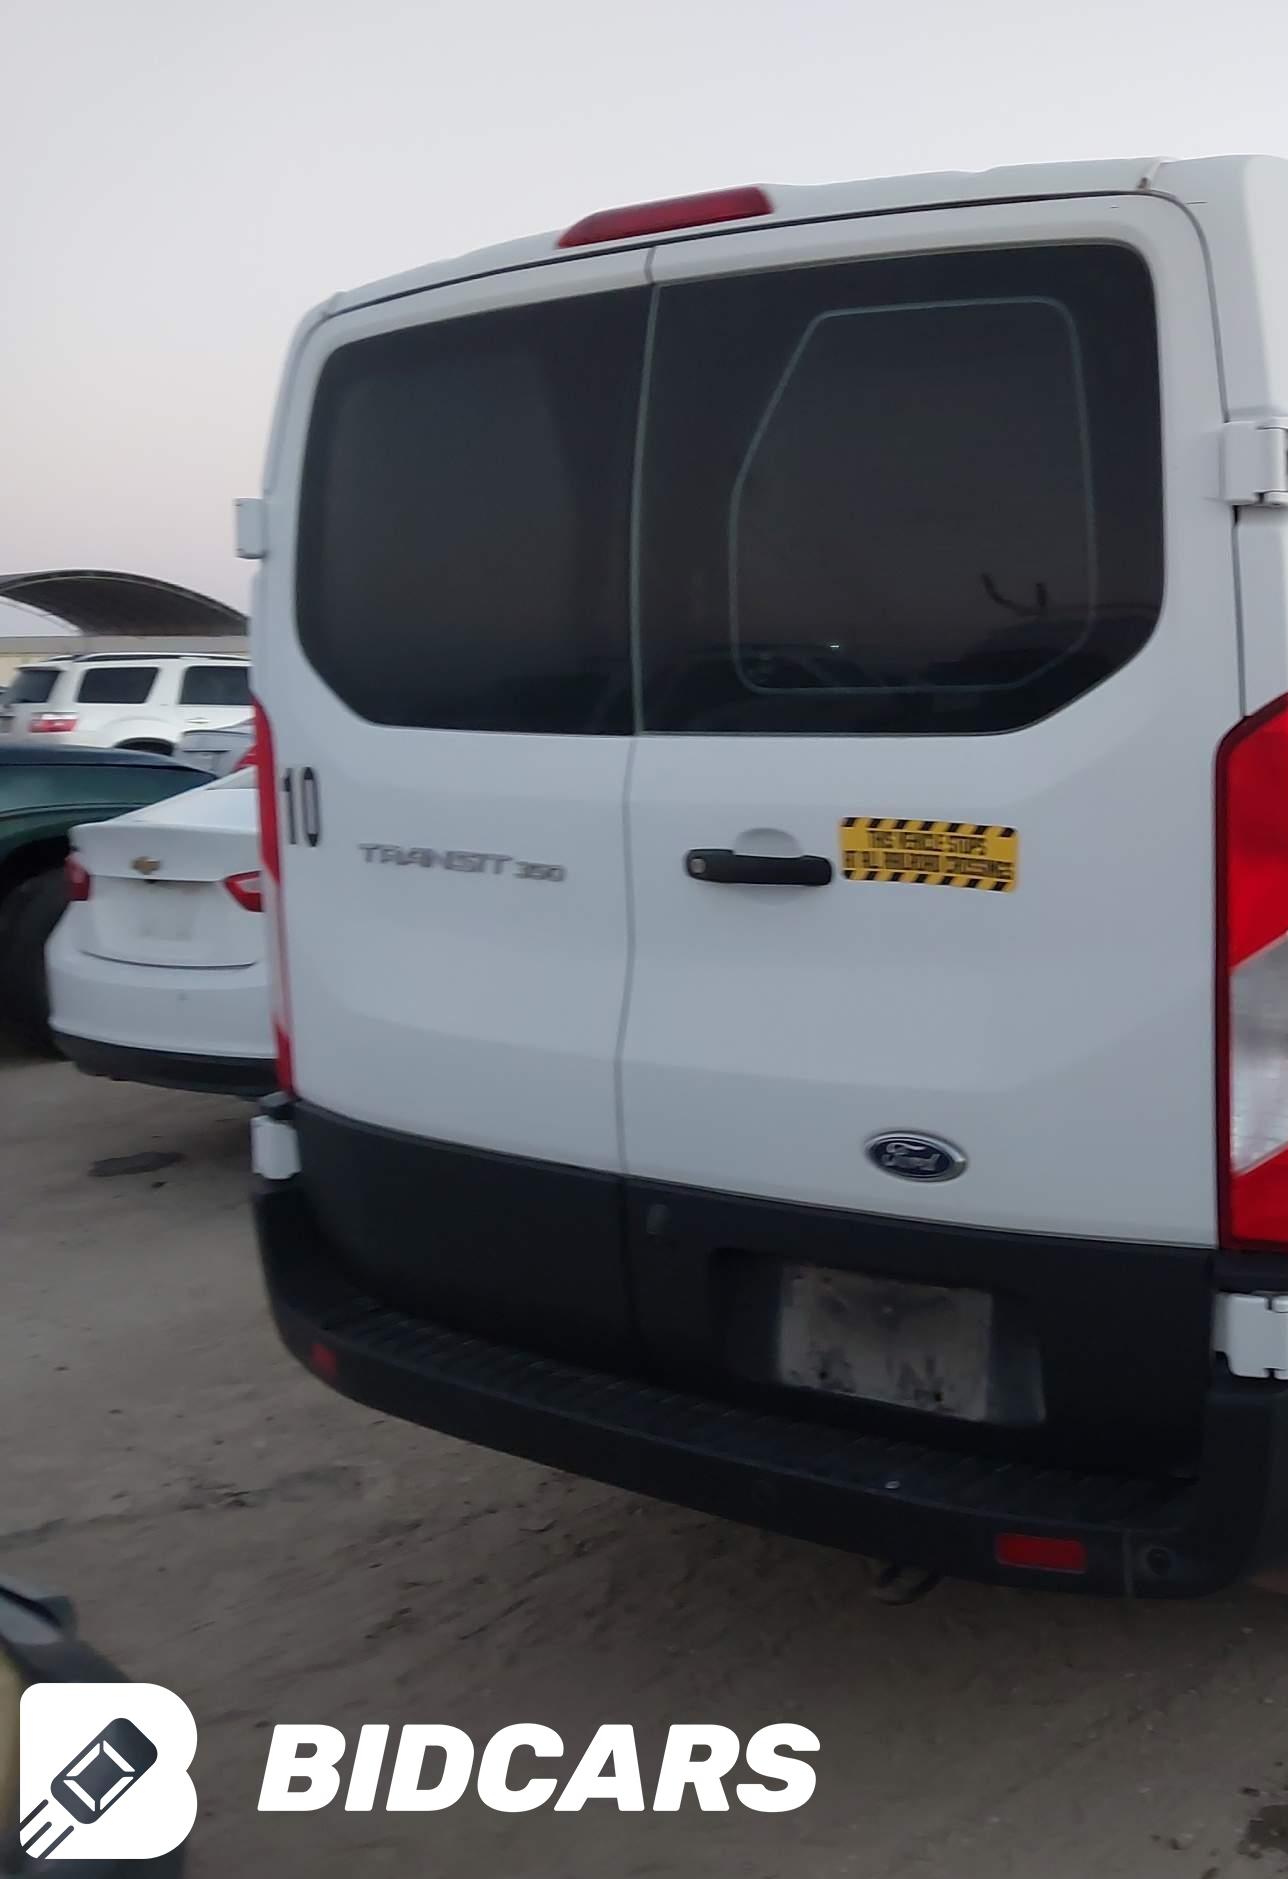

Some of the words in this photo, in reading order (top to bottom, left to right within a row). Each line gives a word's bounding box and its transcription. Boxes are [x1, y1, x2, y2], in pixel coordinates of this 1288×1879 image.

[283, 766, 320, 848] 10
[357, 843, 513, 875] TRANSIT
[512, 861, 566, 882] 350
[880, 1141, 941, 1171] Ford
